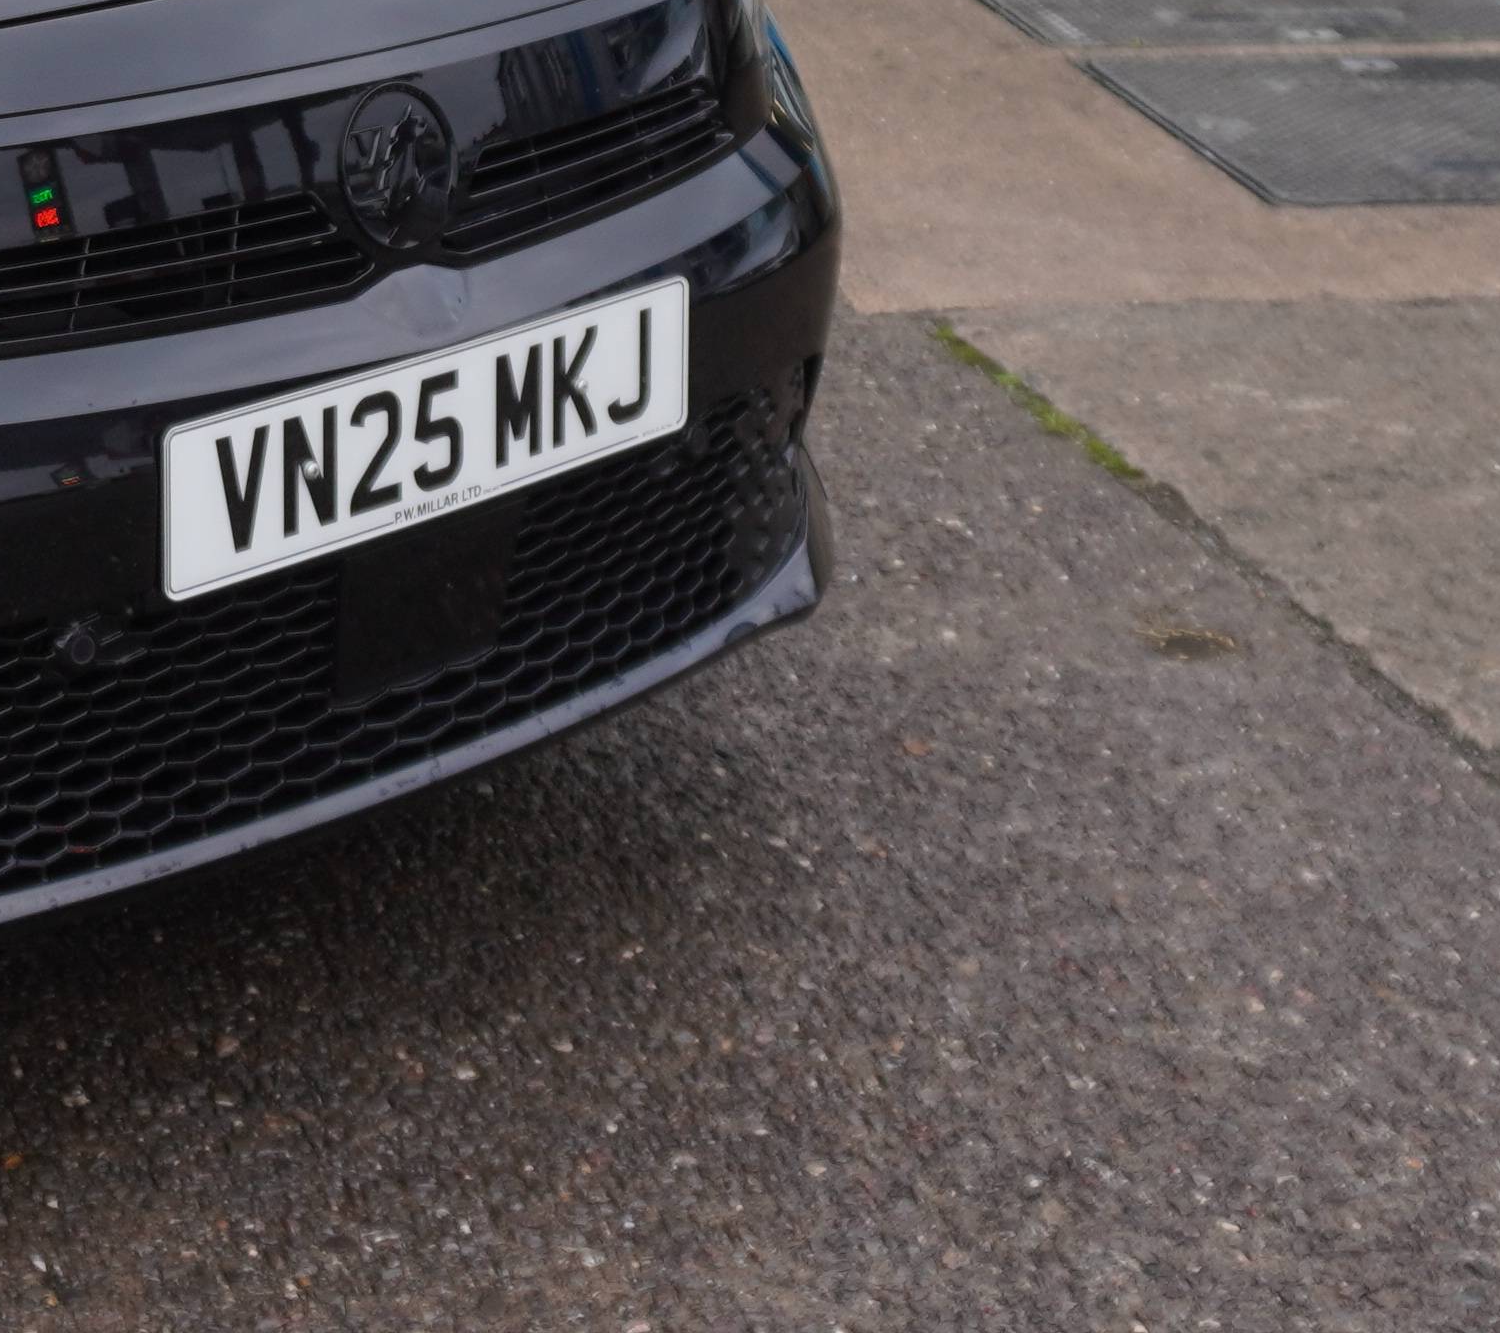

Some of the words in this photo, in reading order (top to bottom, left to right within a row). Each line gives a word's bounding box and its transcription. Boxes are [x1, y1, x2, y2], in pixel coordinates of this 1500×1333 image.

[215, 369, 464, 555] VN25
[496, 307, 652, 470] MKJ
[462, 485, 482, 502] LTD
